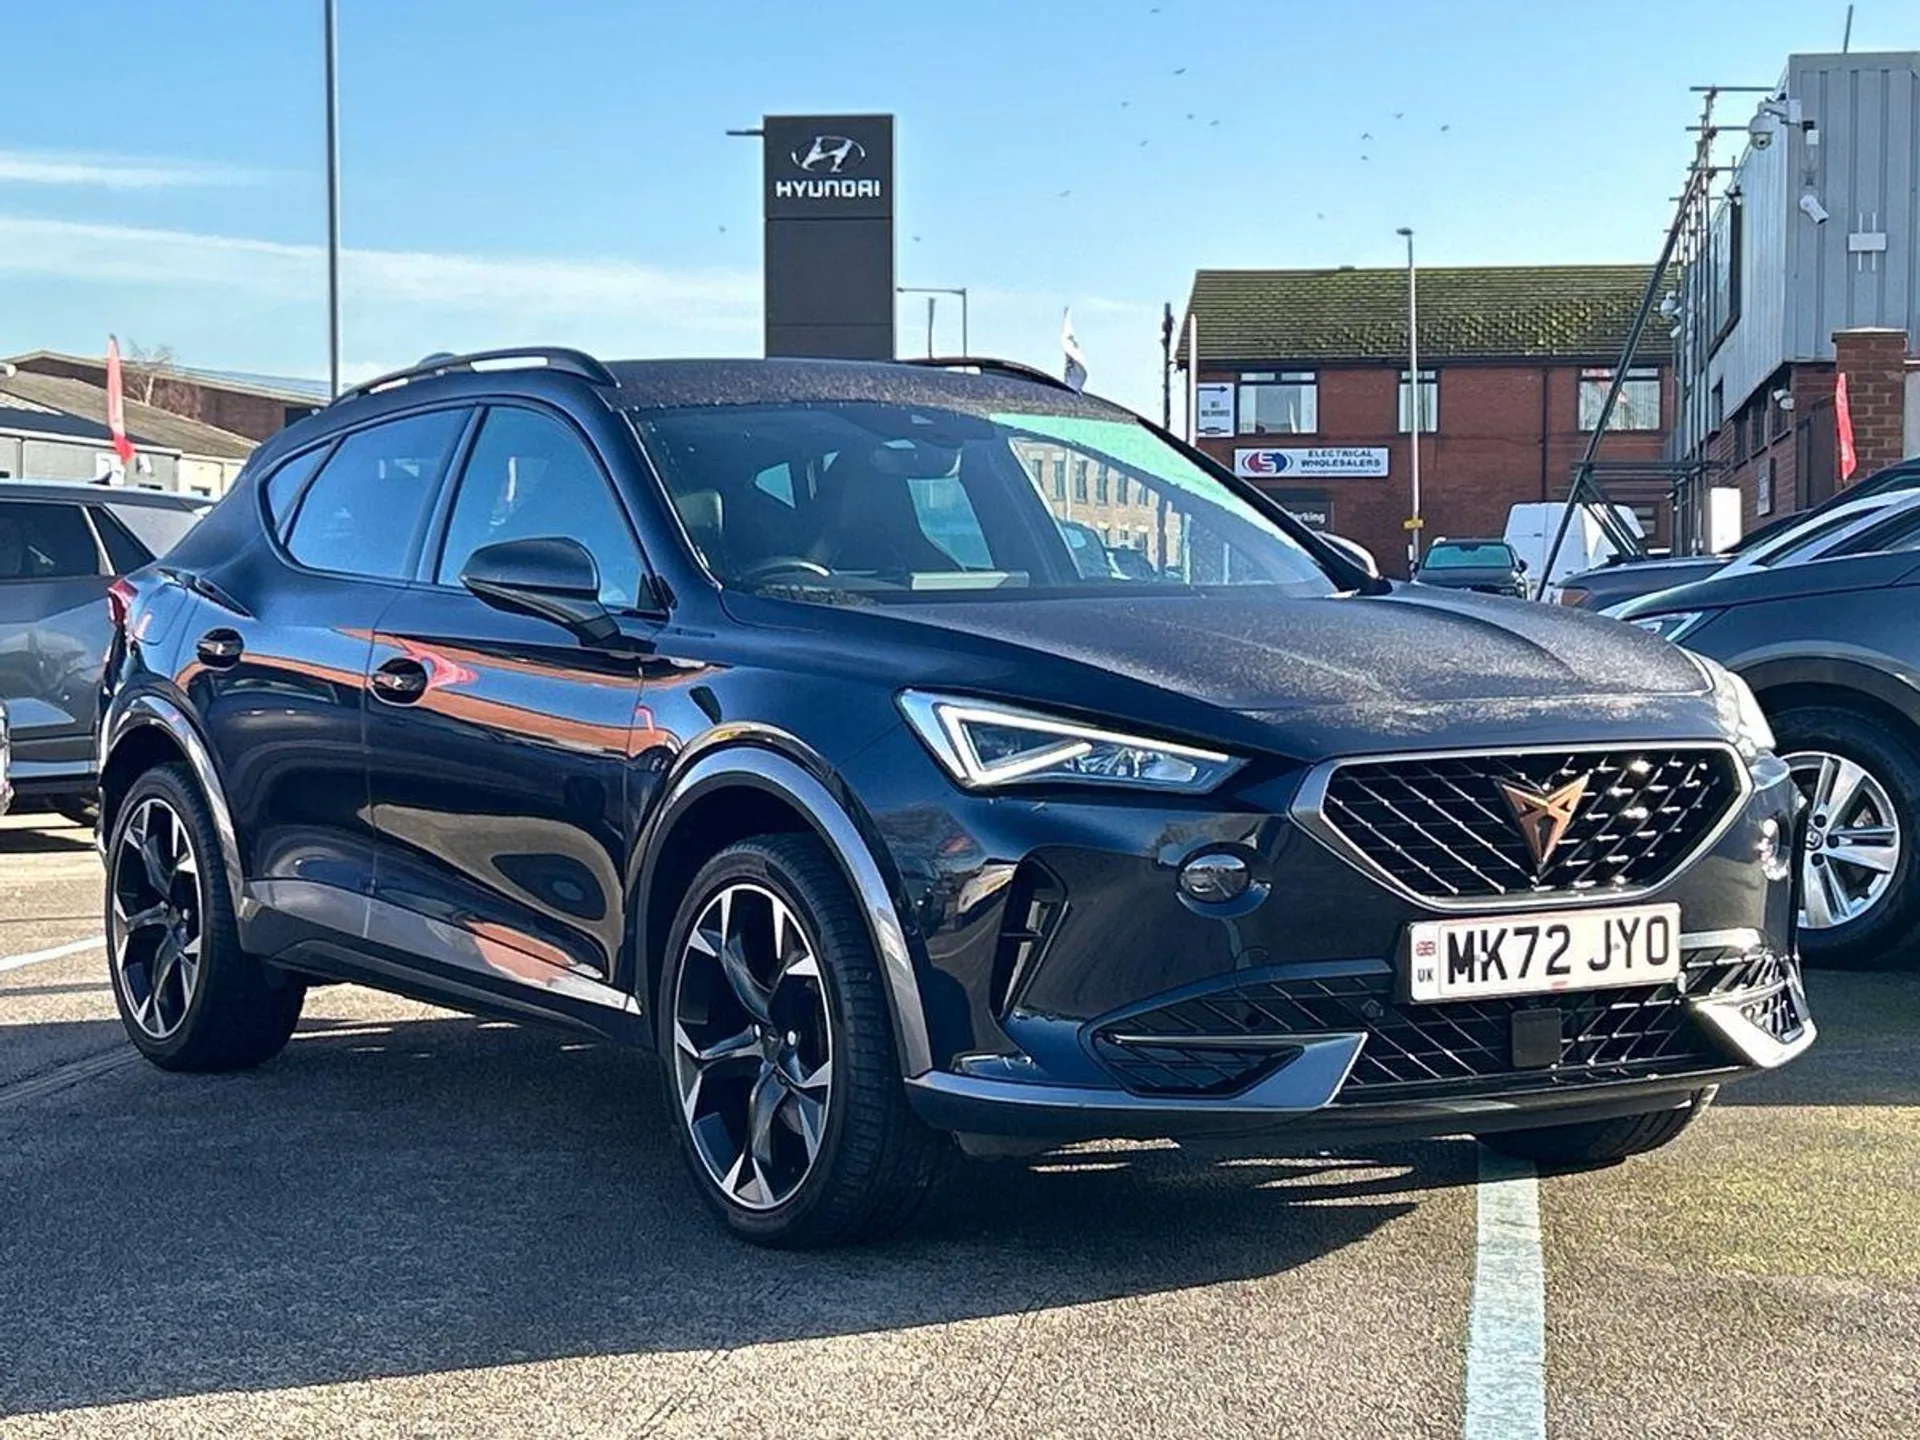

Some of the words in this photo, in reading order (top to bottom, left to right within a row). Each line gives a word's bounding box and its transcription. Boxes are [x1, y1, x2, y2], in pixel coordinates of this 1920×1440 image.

[775, 180, 881, 198] HYUNDAI
[1308, 449, 1373, 458] ELECTRICAL
[1300, 459, 1381, 468] WHOLESALERS
[1447, 924, 1571, 985] MK72
[1588, 915, 1669, 971] JYO
[1417, 968, 1434, 983] UK
